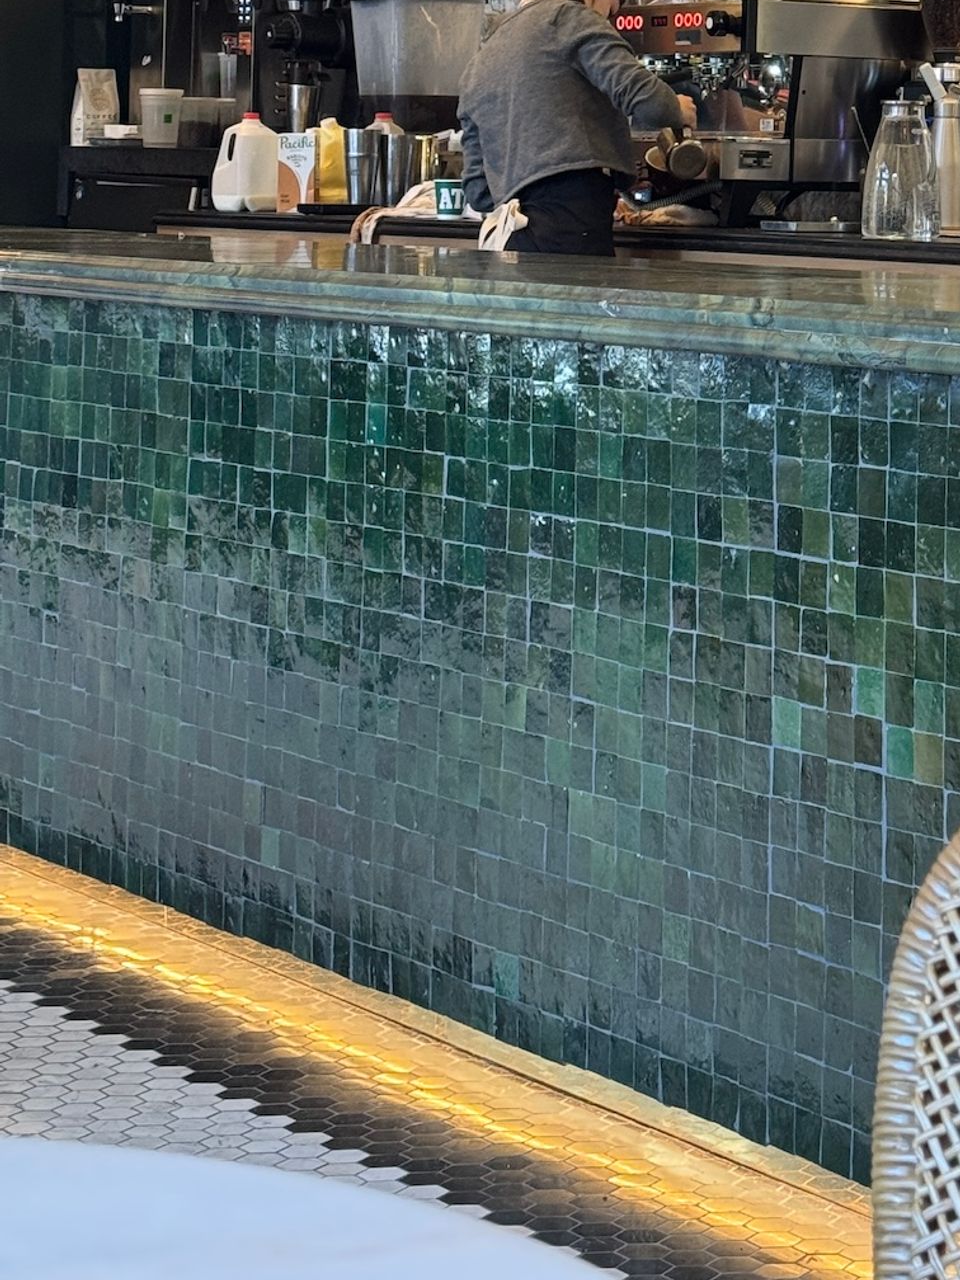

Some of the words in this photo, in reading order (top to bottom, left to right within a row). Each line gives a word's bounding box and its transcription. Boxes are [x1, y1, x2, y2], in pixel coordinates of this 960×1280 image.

[616, 15, 643, 30] 000
[675, 12, 702, 28] 000
[280, 135, 316, 150] Pacific
